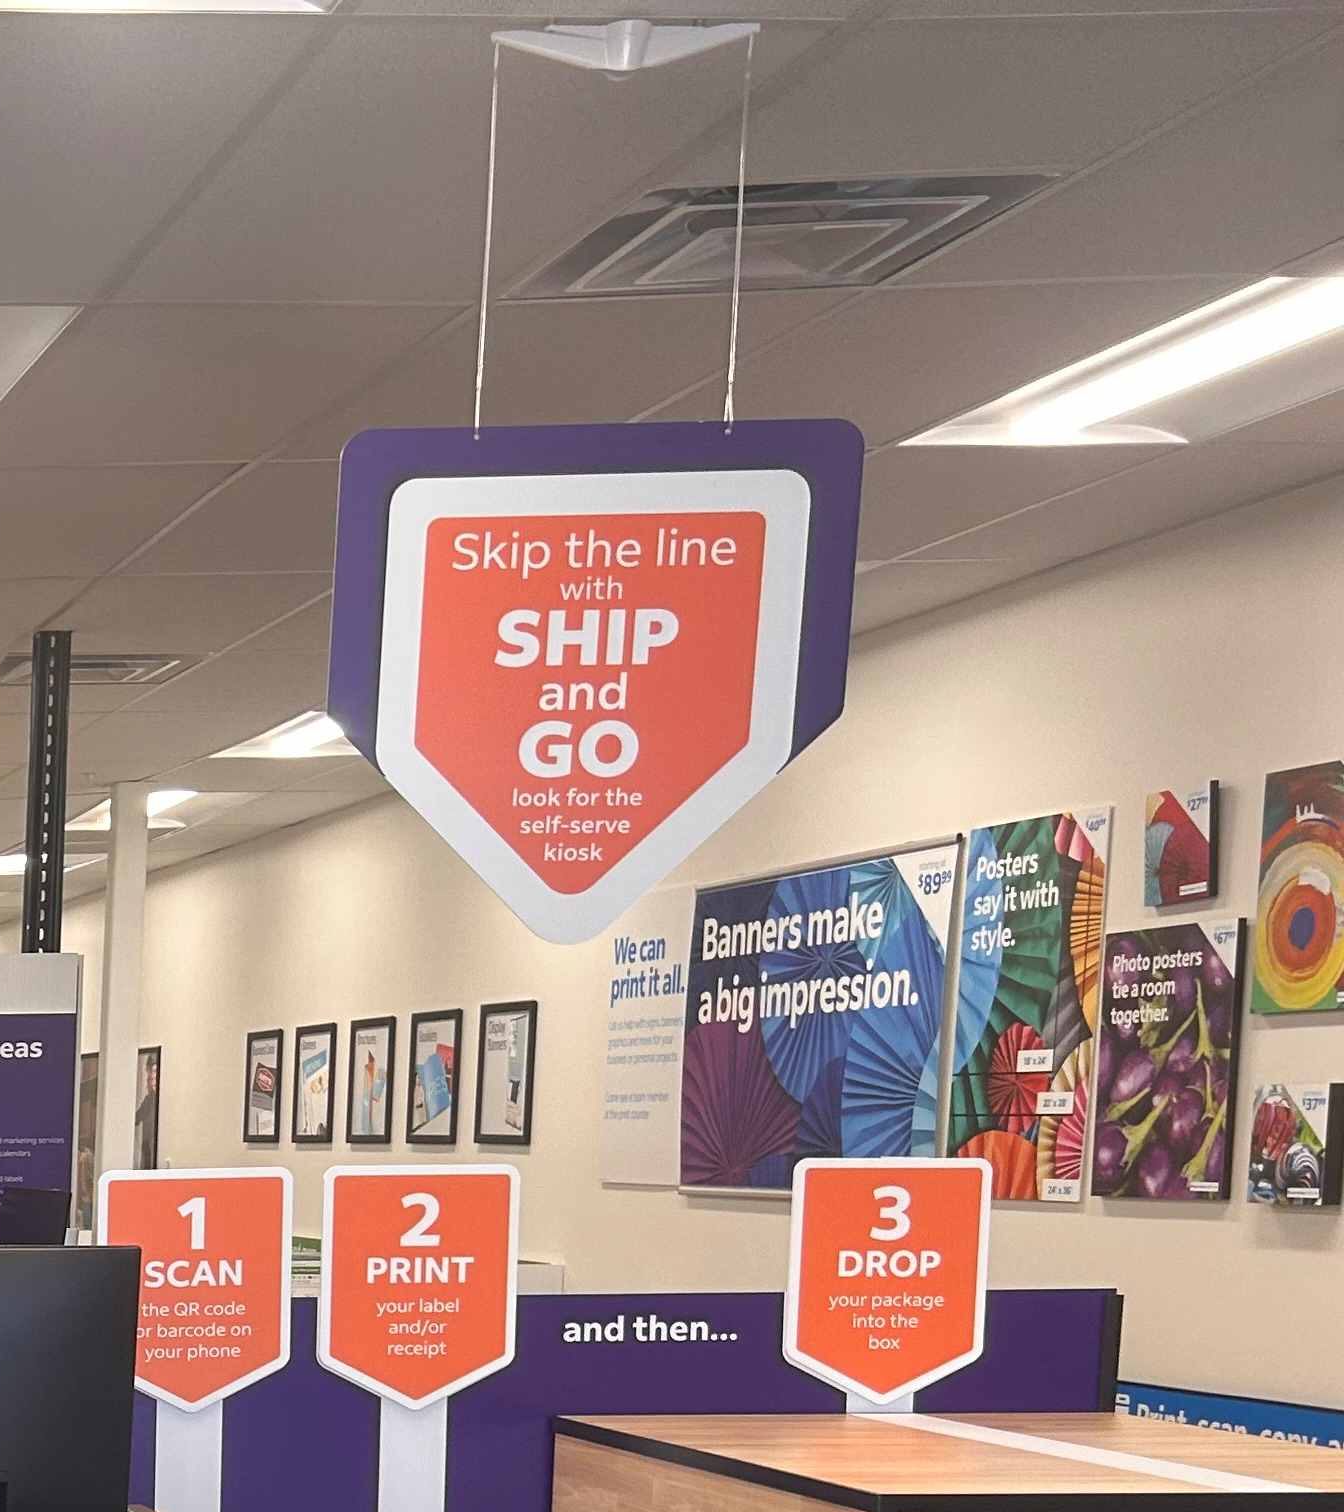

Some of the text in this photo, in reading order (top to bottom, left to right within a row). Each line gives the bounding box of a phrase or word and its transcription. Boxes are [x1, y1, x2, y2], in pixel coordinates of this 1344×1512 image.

[451, 528, 737, 579] Skip the line
[560, 577, 623, 601] with
[494, 608, 679, 668] SHIP
[538, 672, 628, 711] and
[518, 720, 639, 779] GO
[513, 787, 643, 807] look for the
[519, 816, 631, 835] self-serve
[543, 843, 603, 862] kiosk
[976, 852, 1039, 882] Posters
[974, 880, 1059, 921] say it with
[702, 891, 884, 961] Banners make
[971, 921, 1016, 956] style.
[614, 937, 666, 965] We can
[1112, 949, 1203, 975] Photo posters
[610, 964, 685, 1008] print it all.
[697, 958, 919, 1034] a big impression.
[1112, 980, 1176, 999] tie a room
[1110, 1003, 1169, 1029] together.
[177, 1197, 206, 1250] 1
[399, 1192, 441, 1247] 2
[870, 1185, 911, 1241] 3
[144, 1259, 243, 1288] SCAN
[366, 1256, 475, 1284] PRINT
[838, 1250, 942, 1278] DROP
[142, 1302, 246, 1318] the QR code
[376, 1298, 460, 1317] your label
[828, 1291, 945, 1311] your package
[137, 1323, 251, 1338] or barcode on
[388, 1320, 448, 1336] and/or
[563, 1314, 739, 1342] and then...
[852, 1313, 919, 1328] into the
[144, 1344, 241, 1362] your phone
[386, 1342, 447, 1358] receipt
[868, 1334, 900, 1350] box
